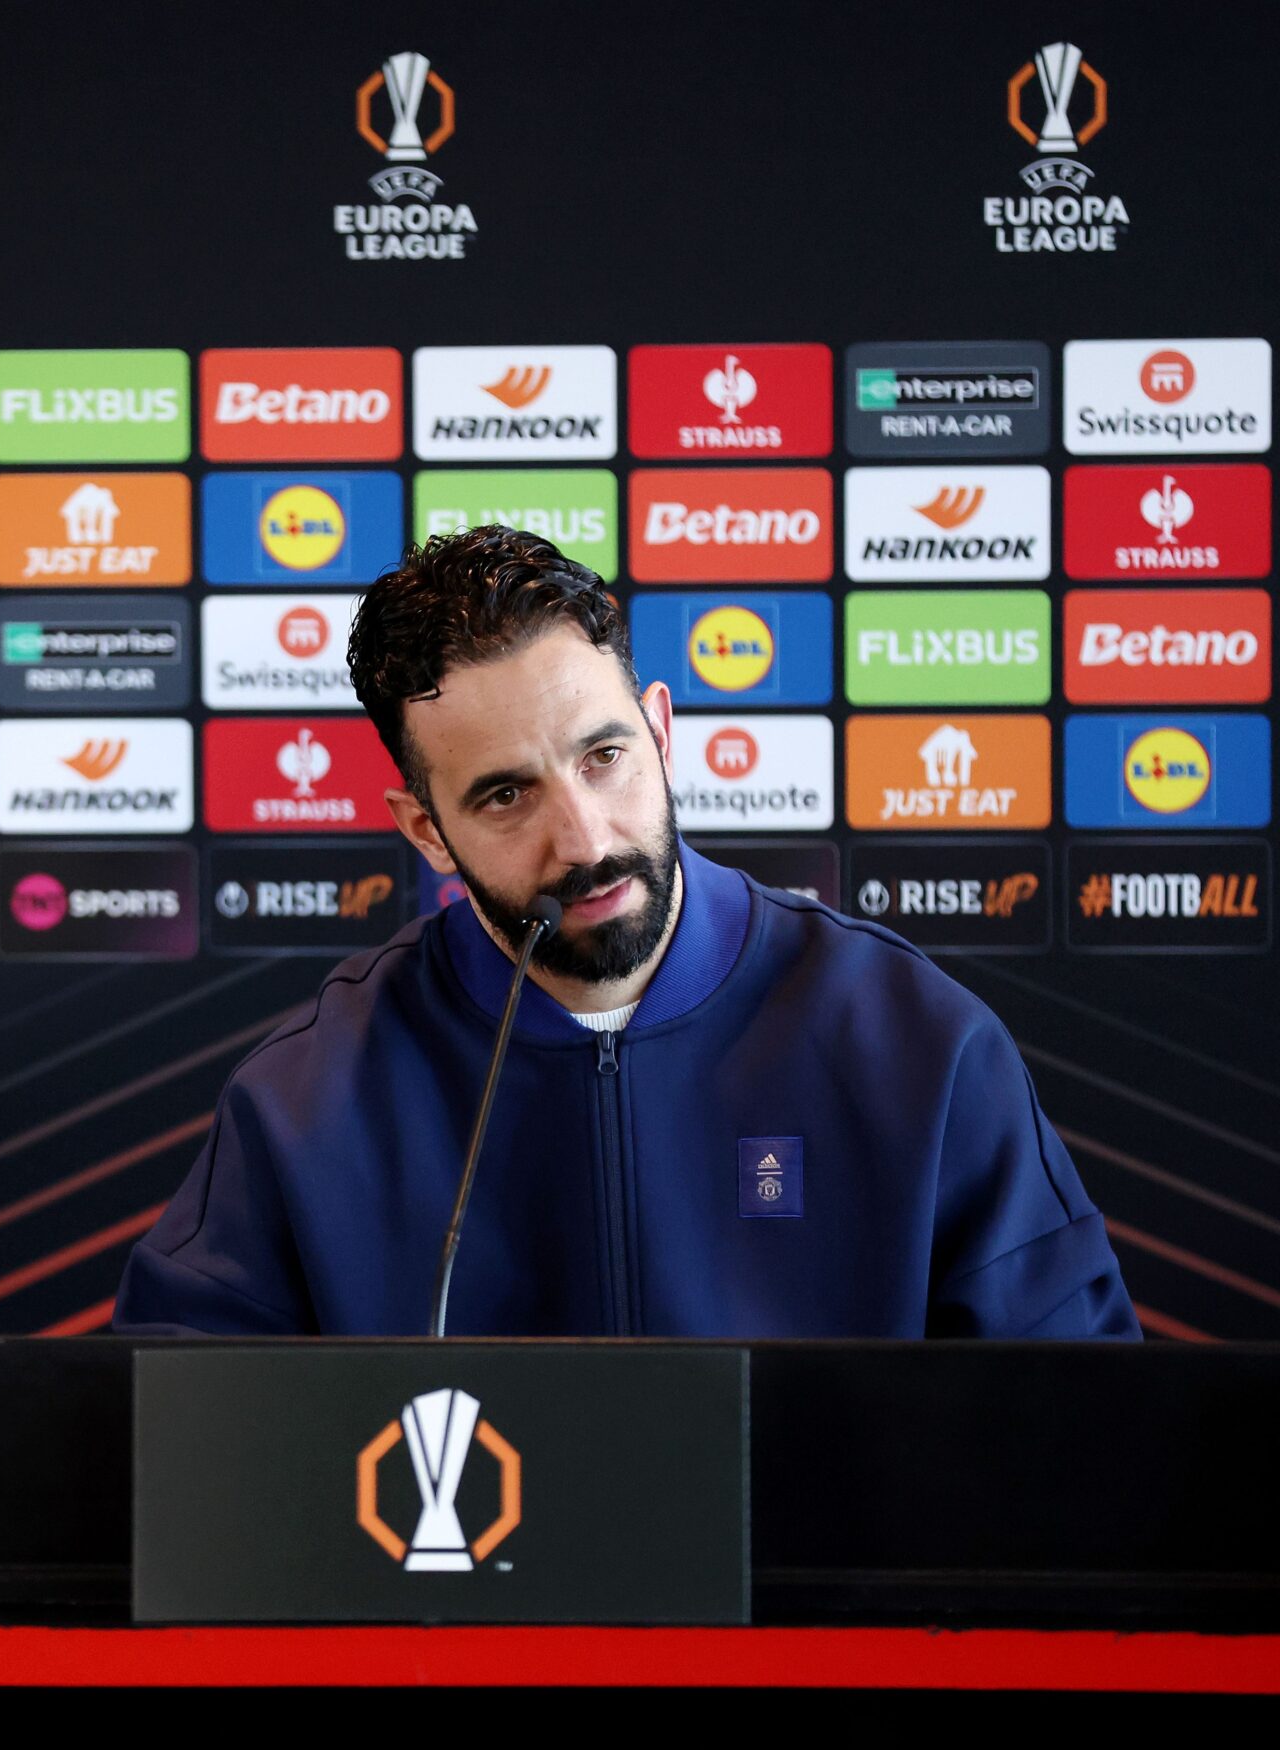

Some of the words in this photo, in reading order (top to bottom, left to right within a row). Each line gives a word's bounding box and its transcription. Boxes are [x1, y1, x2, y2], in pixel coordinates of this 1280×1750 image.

[376, 173, 437, 197] UEFA
[1026, 164, 1088, 188] UEFA
[333, 204, 479, 234] EUROPA
[983, 195, 1130, 226] EUROPA
[346, 233, 465, 260] LEAGUE
[995, 223, 1117, 253] LEAGUE
[214, 382, 391, 424] Betano
[869, 374, 1034, 403] enterprise
[678, 425, 783, 449] STRAUSS
[880, 414, 1012, 437] RENT-A-CAR
[1078, 407, 1257, 441] Swissquote
[643, 502, 820, 545] Betano
[24, 548, 100, 577] JUST
[101, 545, 158, 575] EAT
[1115, 546, 1220, 569] STRAUSS
[1078, 623, 1259, 667] Betano
[25, 668, 155, 691] RENT-A-CAR
[218, 661, 353, 697] Swissquo
[253, 798, 356, 822] STRAUSS
[670, 782, 822, 820] wissquote
[881, 791, 956, 819] JUST
[962, 788, 1017, 818] EAT
[68, 889, 180, 918] SPORTS
[1078, 873, 1259, 918] #FOOTBALL
